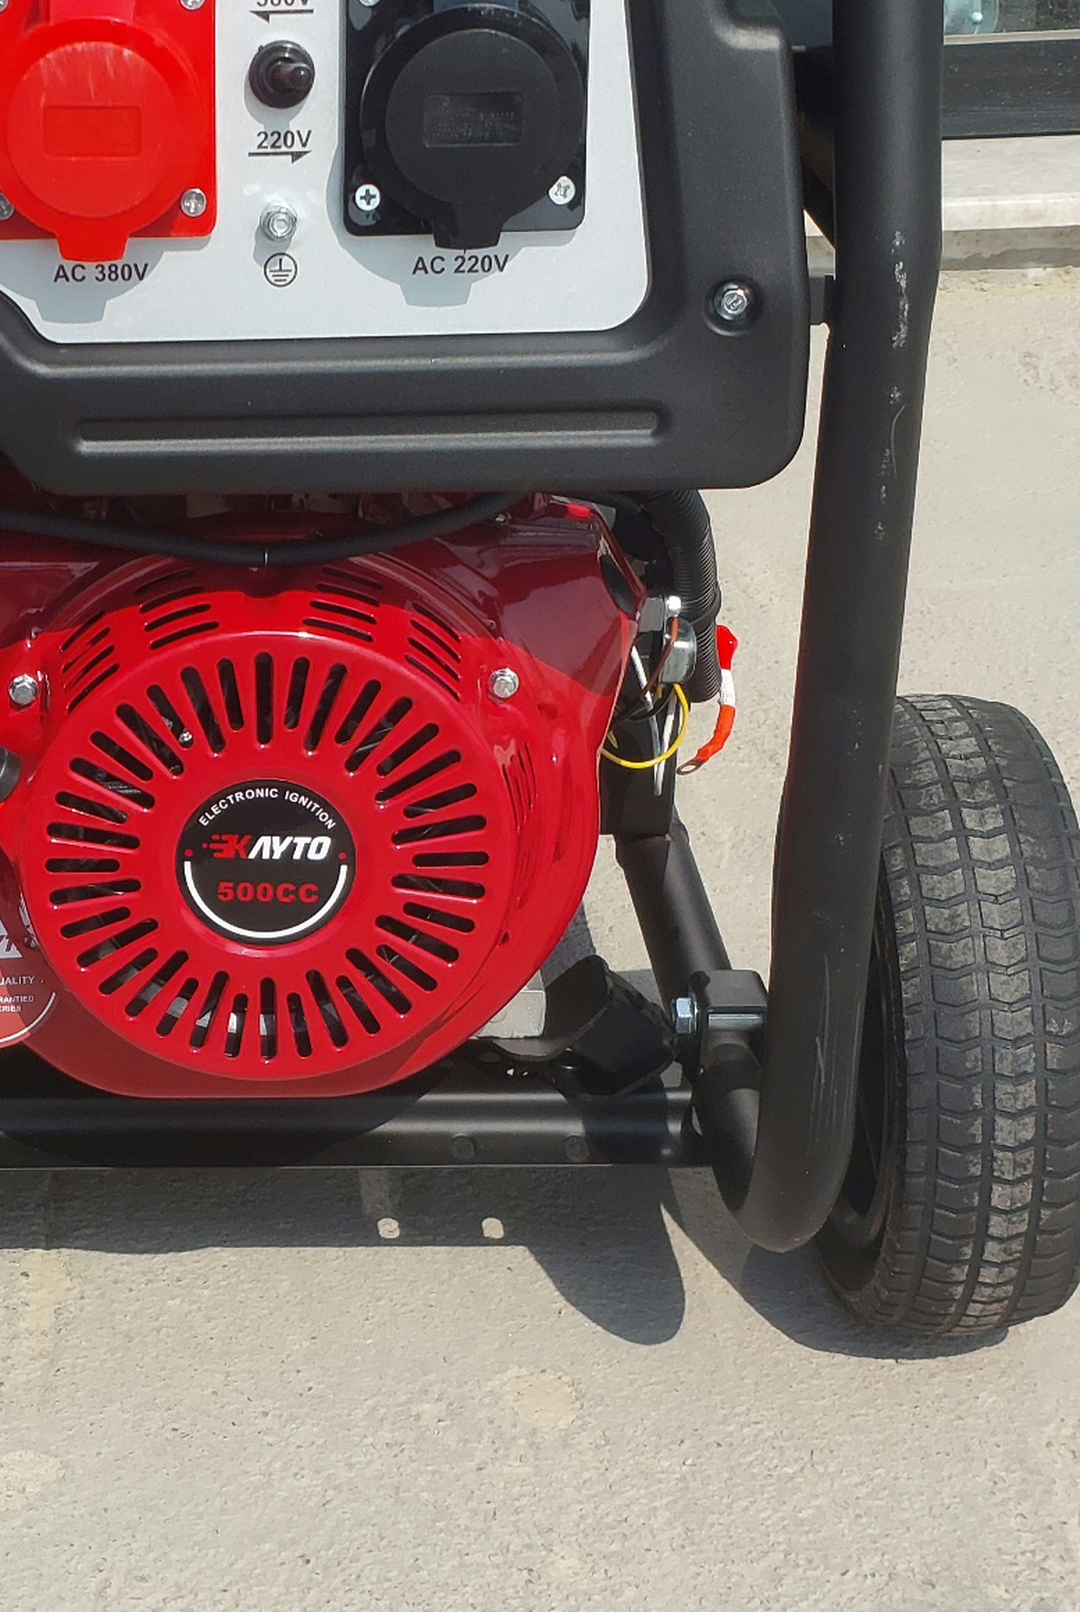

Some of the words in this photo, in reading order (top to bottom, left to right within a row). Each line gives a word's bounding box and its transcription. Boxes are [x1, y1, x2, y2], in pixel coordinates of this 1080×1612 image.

[256, 130, 313, 150] 220V
[53, 264, 87, 283] AC
[94, 263, 149, 282] 380V
[412, 256, 450, 276] AC
[453, 254, 510, 275] 220V
[198, 787, 279, 827] ELECTRONIC
[284, 790, 336, 830] IGNITION
[206, 834, 332, 861] KAYTO
[217, 882, 319, 904] 500CC
